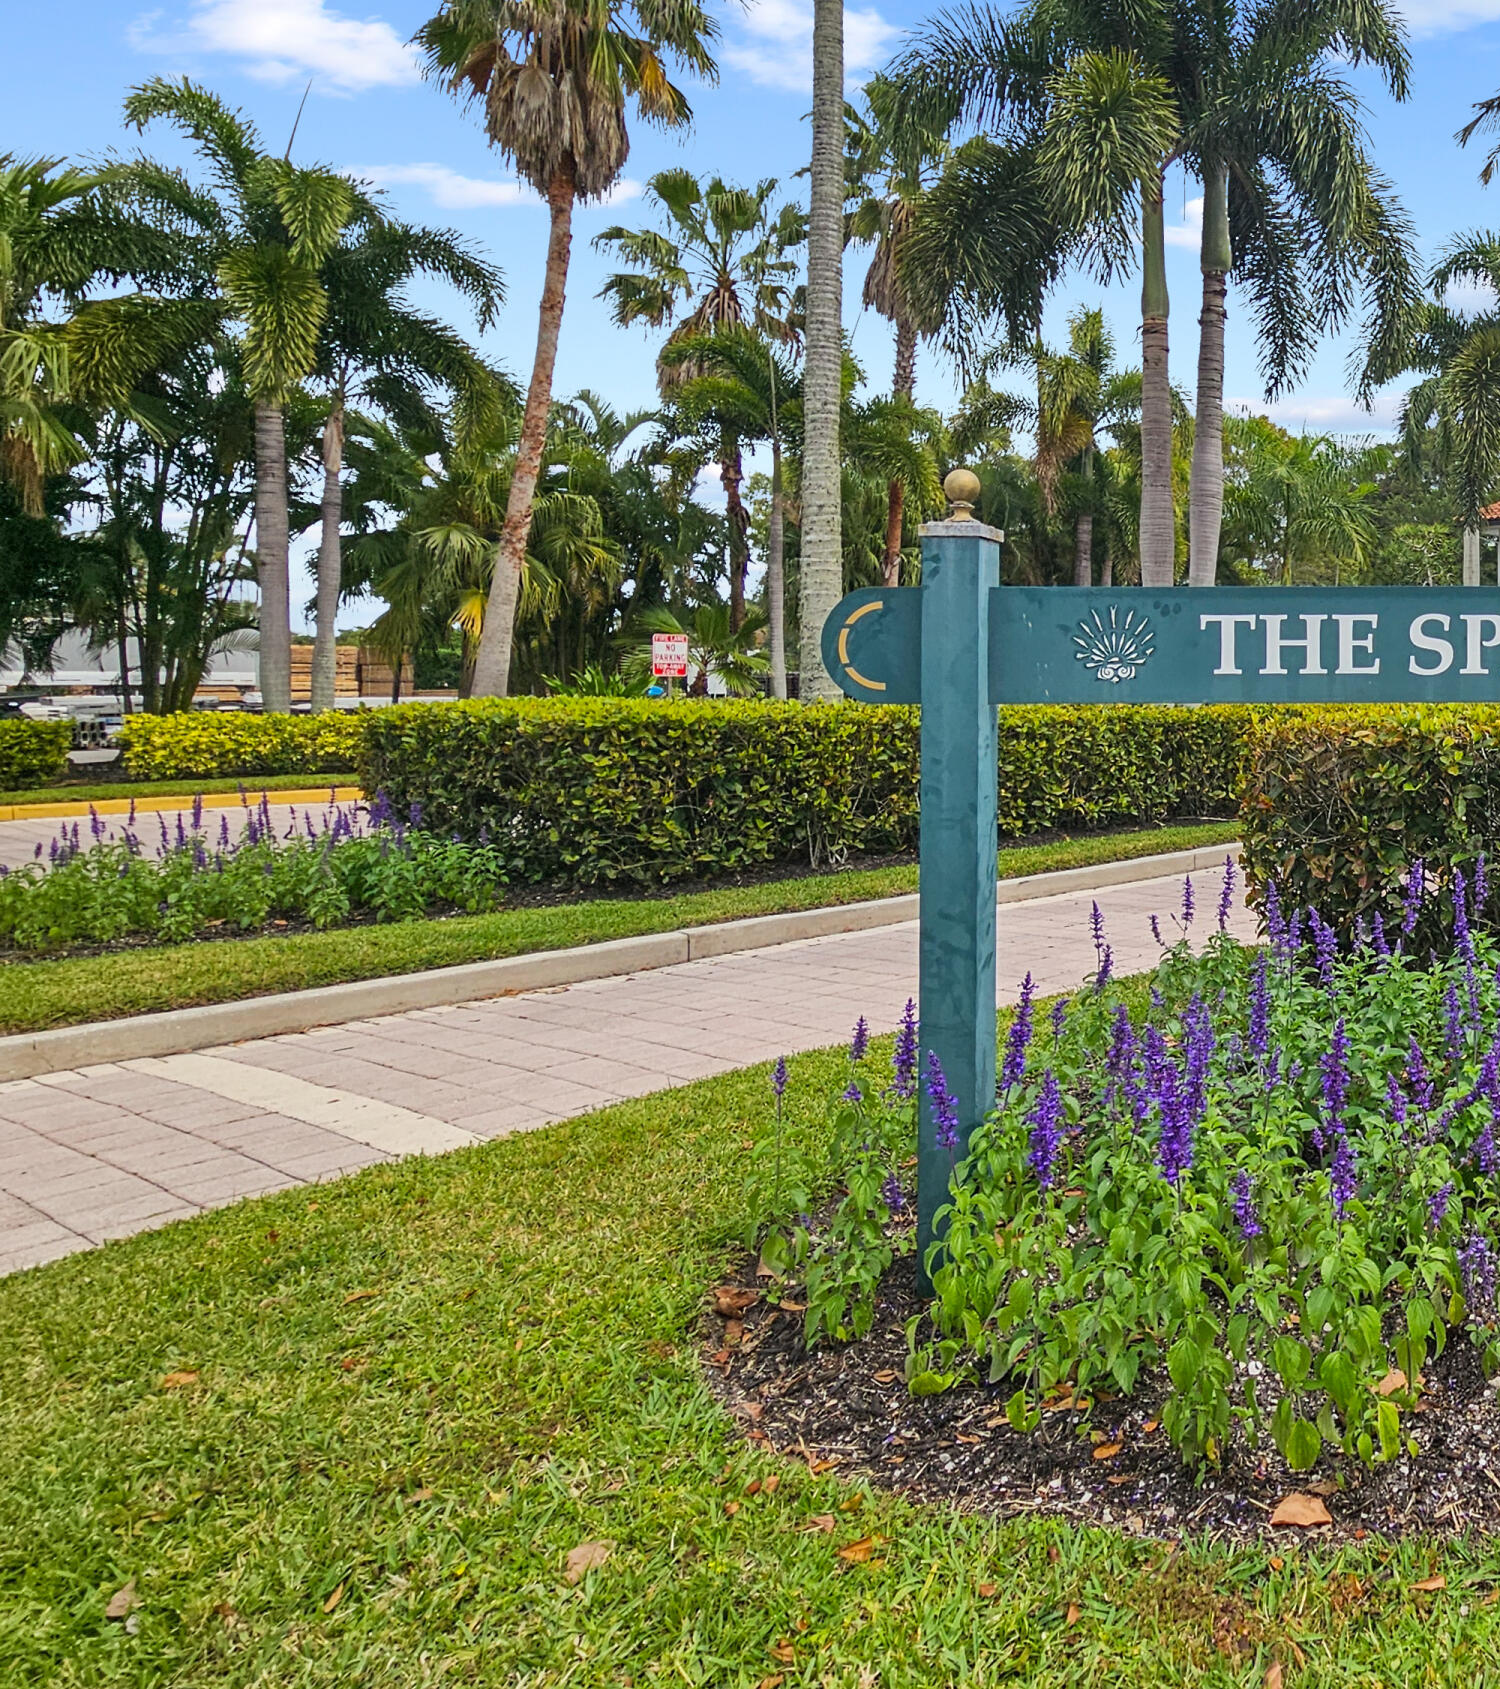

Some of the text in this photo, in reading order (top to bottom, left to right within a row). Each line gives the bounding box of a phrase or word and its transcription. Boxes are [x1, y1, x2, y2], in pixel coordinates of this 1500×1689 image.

[666, 644, 676, 652] NO
[1199, 613, 1381, 675] THE
[655, 654, 685, 662] PARKING
